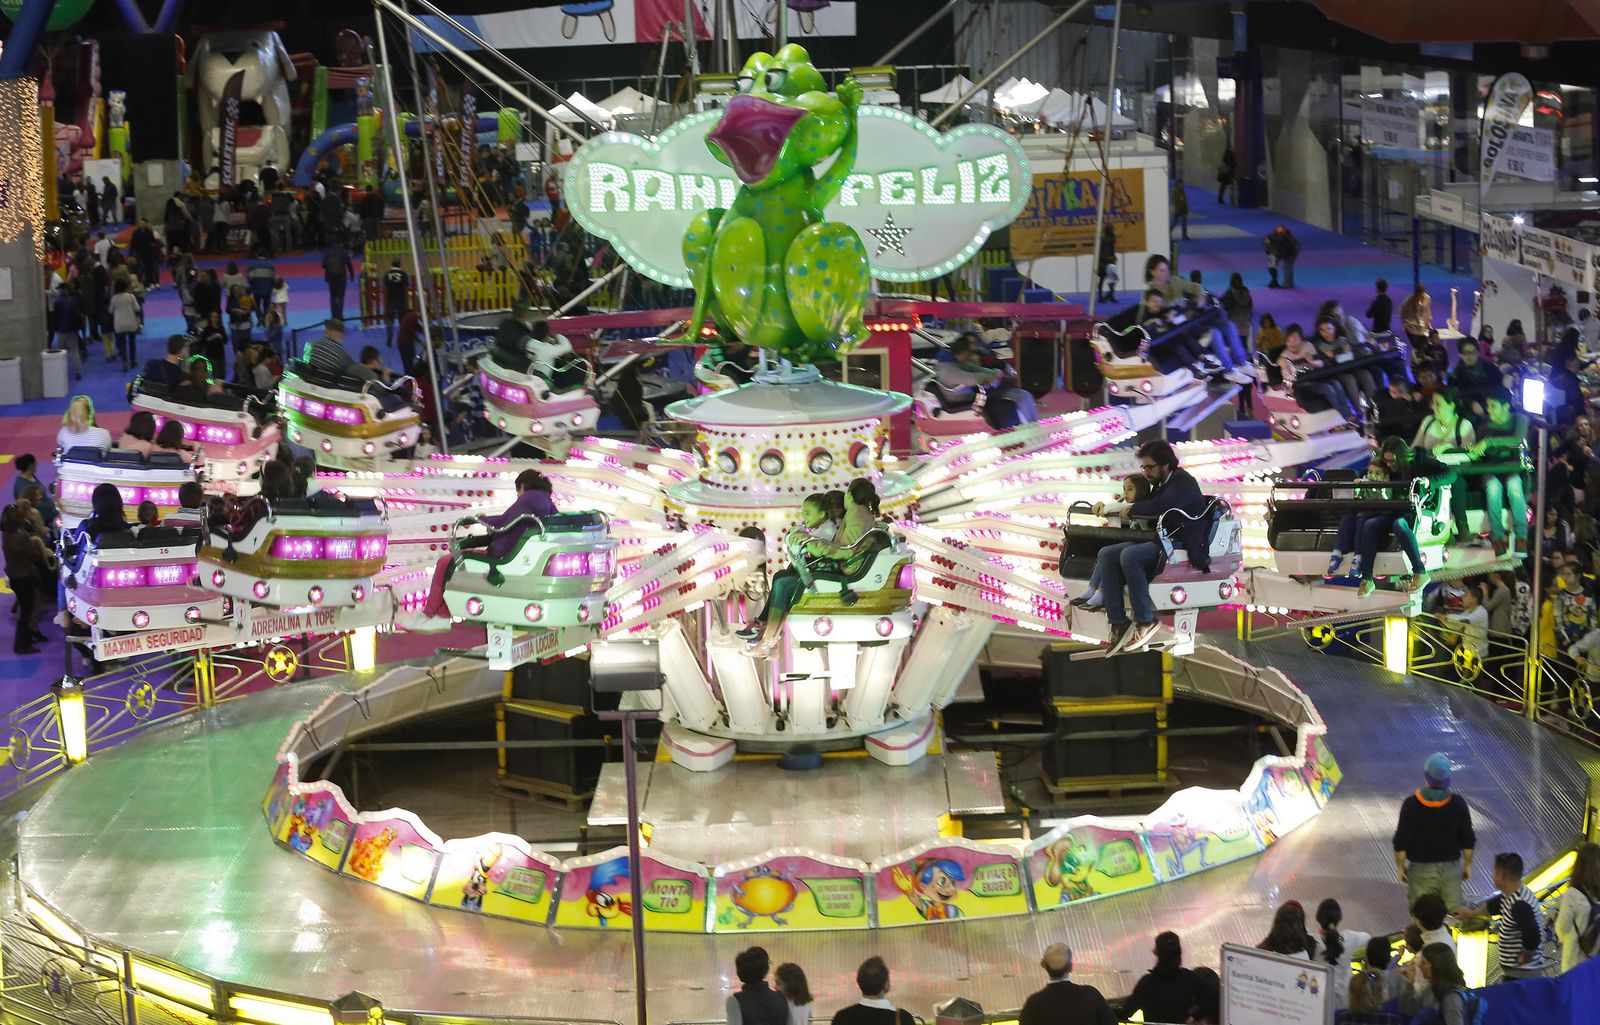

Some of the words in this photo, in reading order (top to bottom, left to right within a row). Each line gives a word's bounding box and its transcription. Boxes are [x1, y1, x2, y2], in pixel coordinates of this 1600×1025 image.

[222, 119, 236, 186] SCALEXTRIC
[587, 161, 740, 212] RANI
[838, 153, 1011, 207] FELIZ
[251, 615, 301, 637] ADRENALINA
[305, 613, 312, 627] A
[314, 610, 336, 626] TOPE
[1180, 620, 1187, 630] 4
[103, 641, 142, 658] MAXIMA
[146, 627, 203, 649] SEGURIDAD
[494, 636, 500, 644] 2
[512, 643, 534, 663] MAXIMA
[535, 630, 559, 654] LOCURA
[659, 896, 679, 908] TIO
